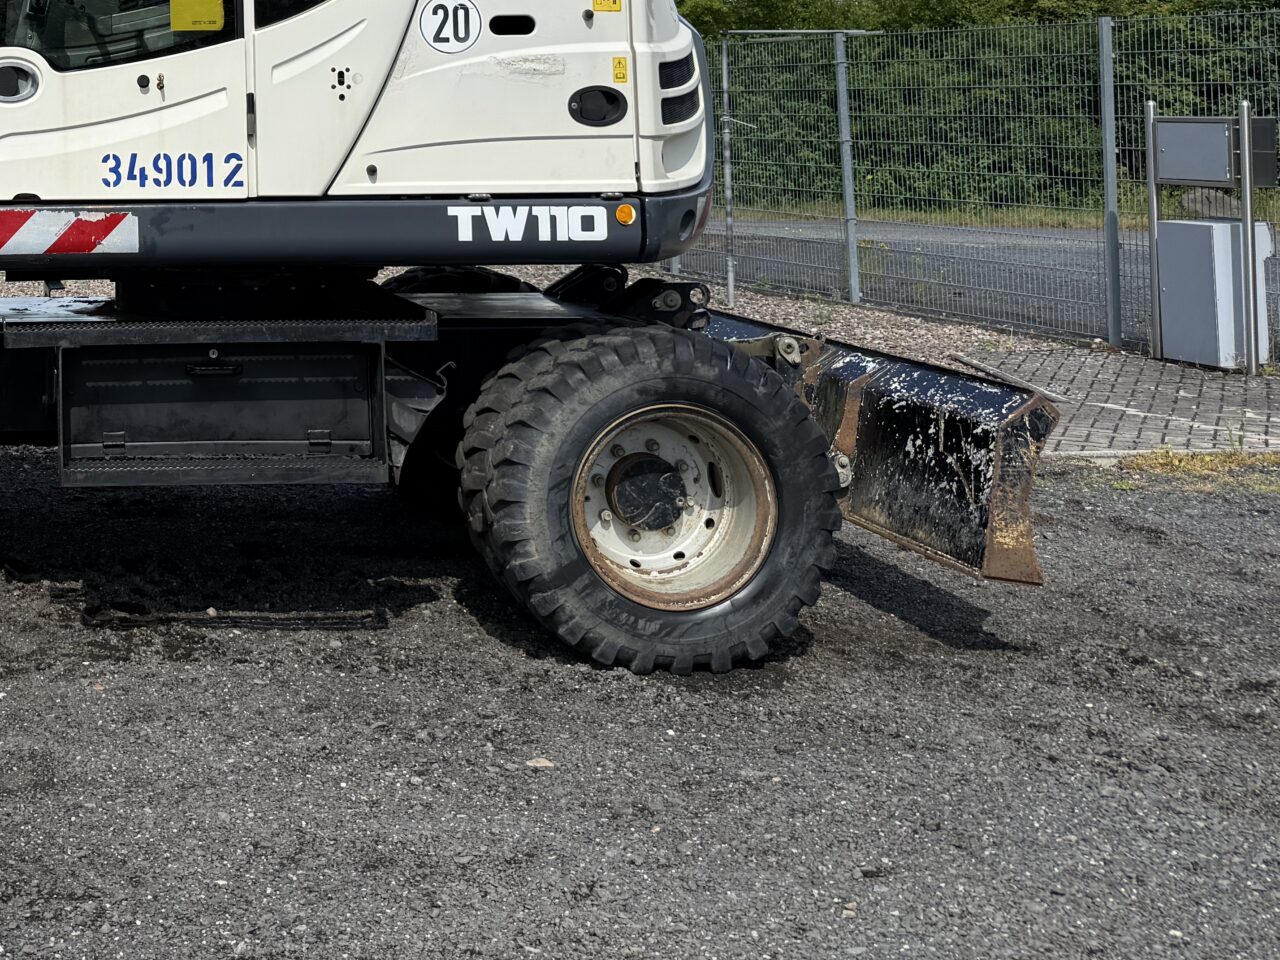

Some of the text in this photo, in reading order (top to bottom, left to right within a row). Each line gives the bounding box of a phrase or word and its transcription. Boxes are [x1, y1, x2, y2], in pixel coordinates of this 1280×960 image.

[432, 3, 470, 43] 20
[101, 152, 244, 188] 349012
[447, 205, 608, 241] TW110
